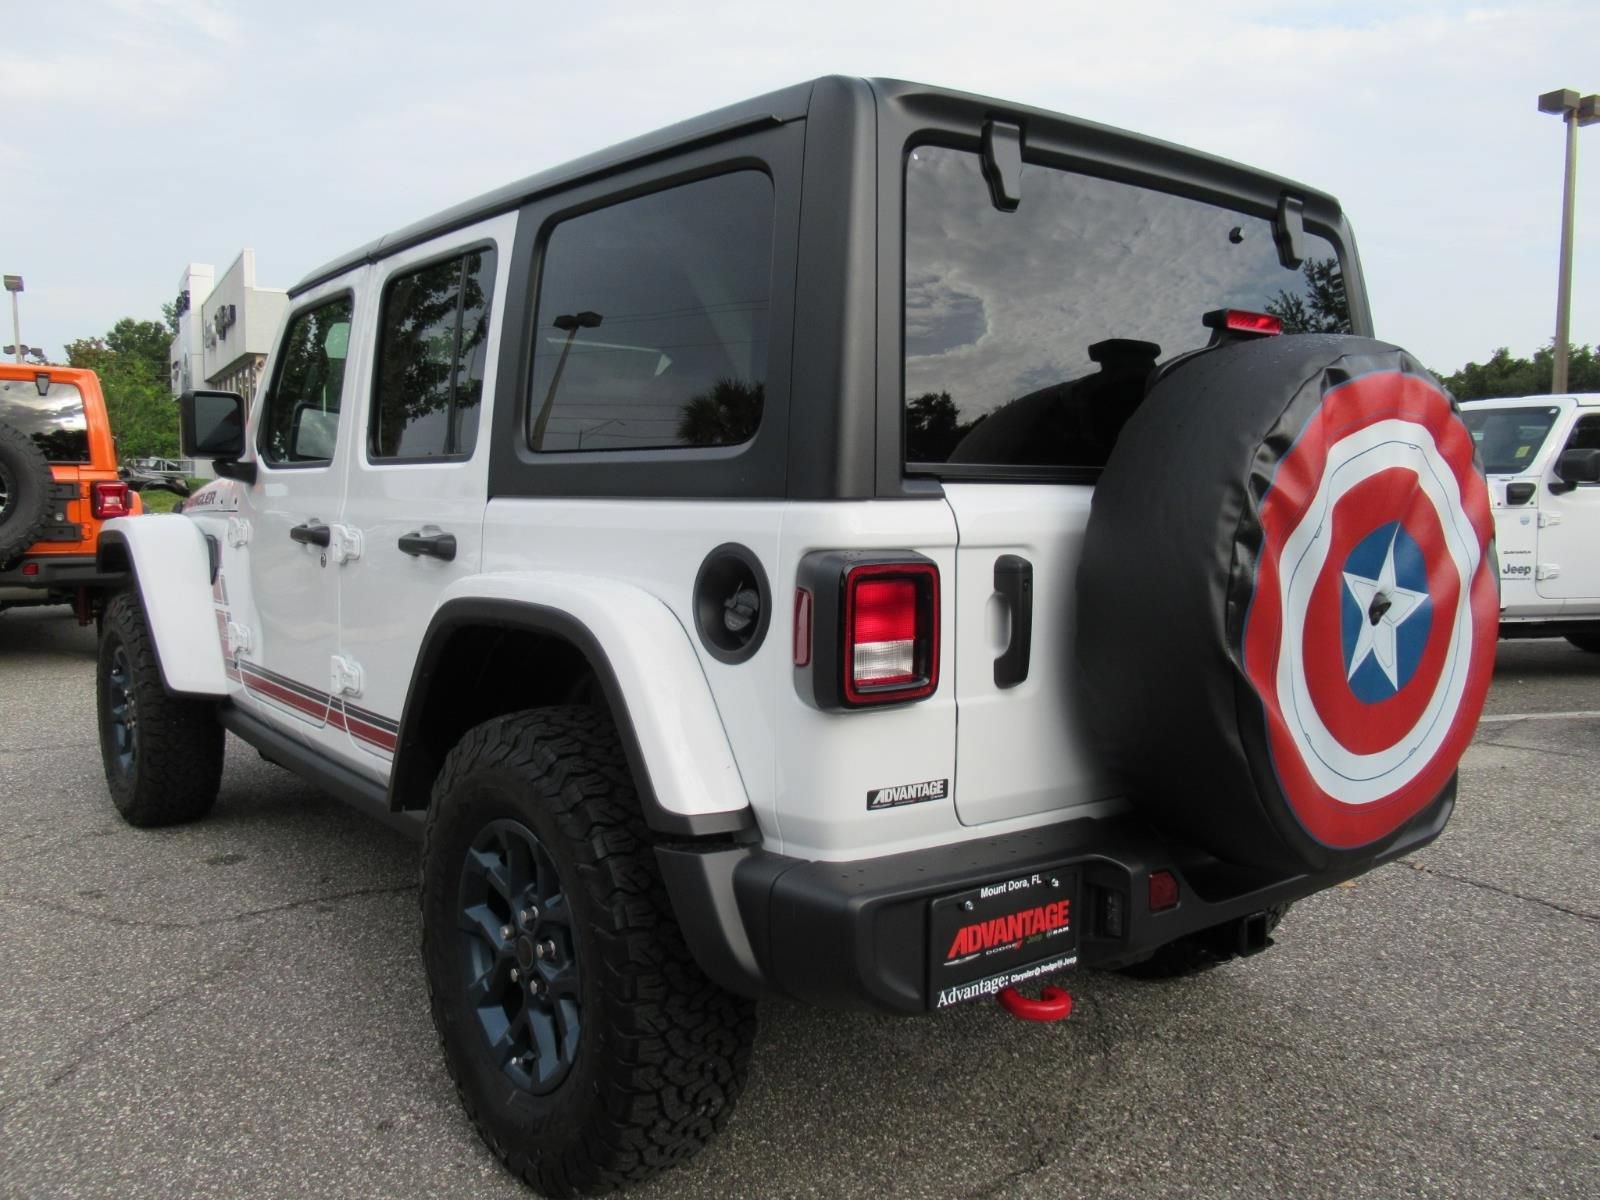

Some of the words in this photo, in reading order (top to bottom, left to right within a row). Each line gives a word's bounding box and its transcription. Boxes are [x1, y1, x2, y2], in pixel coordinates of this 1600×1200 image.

[1502, 563, 1532, 576] Jeep
[873, 780, 944, 804] ADVANTAGE
[980, 883, 1007, 899] Mount
[1008, 879, 1030, 891] Dora,
[1031, 873, 1042, 885] FL
[946, 899, 1071, 960] ADVANTAGE
[936, 974, 1009, 1008] Advantage:
[1063, 956, 1077, 966] Jeep
